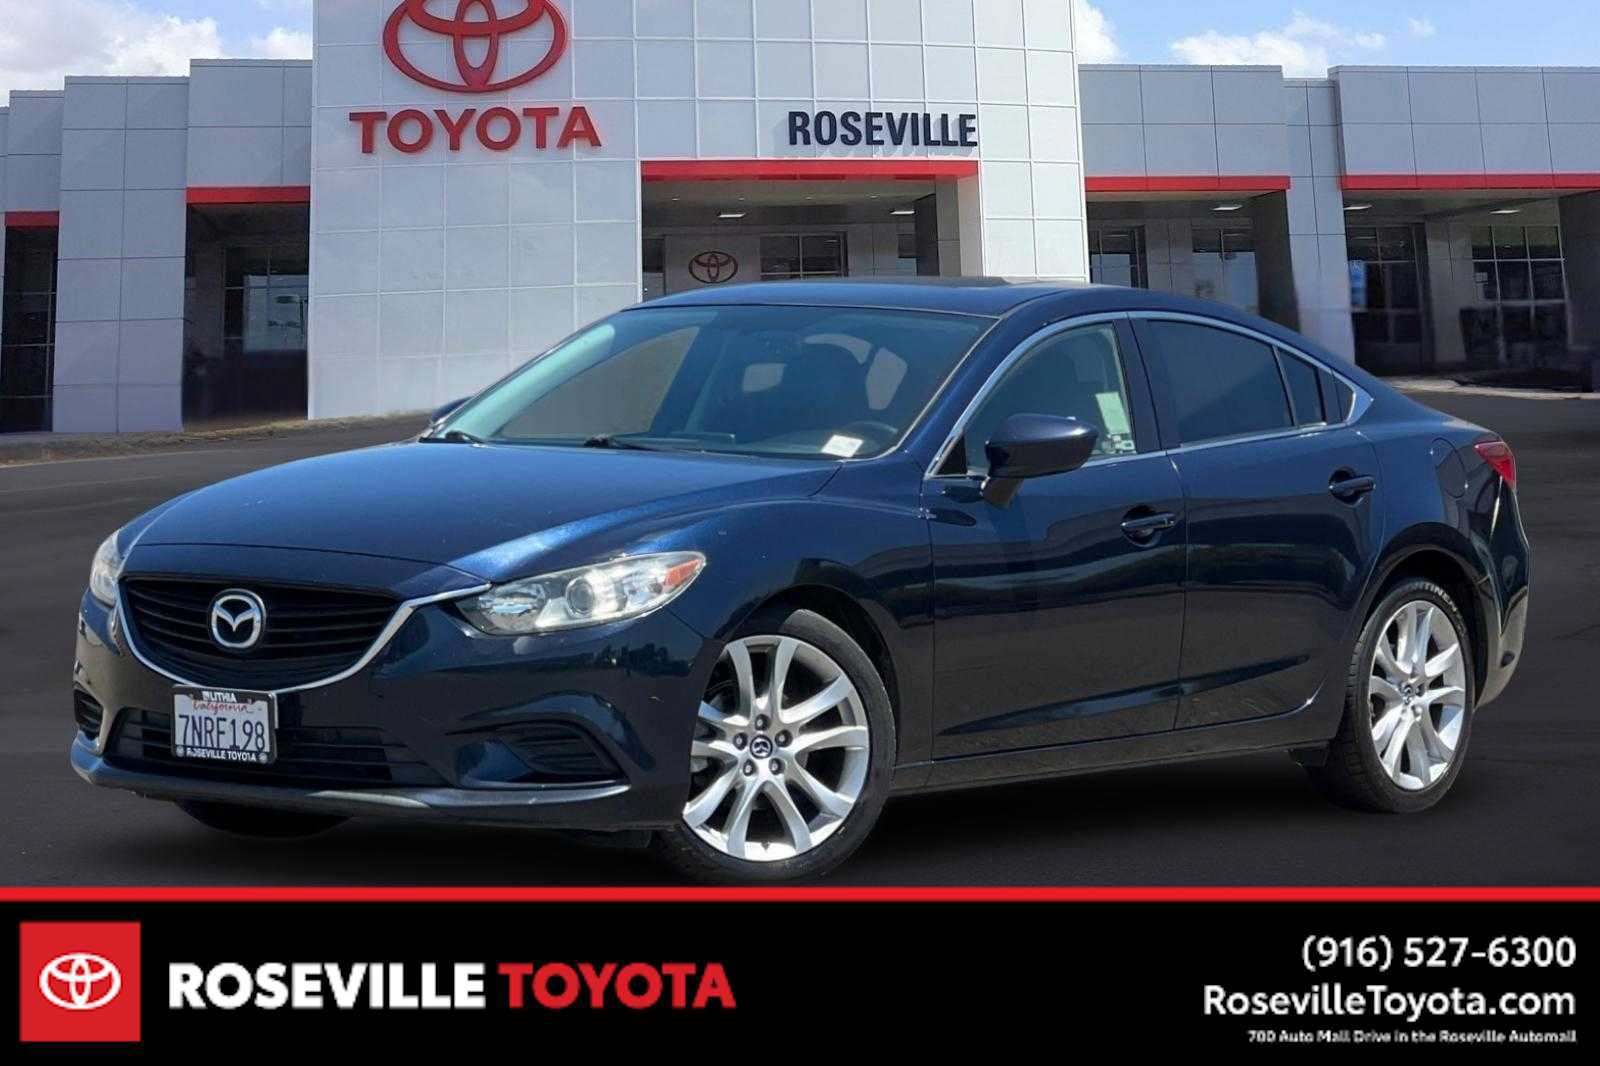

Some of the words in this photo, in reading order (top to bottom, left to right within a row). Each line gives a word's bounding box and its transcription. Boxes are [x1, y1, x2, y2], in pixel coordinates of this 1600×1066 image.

[349, 106, 602, 154] TOYOTA
[788, 110, 978, 148] ROSEVILLE
[192, 698, 255, 715] California
[178, 714, 266, 752] 7NRF198
[187, 747, 226, 759] ROSEVILLE
[227, 750, 258, 762] TOYOTA
